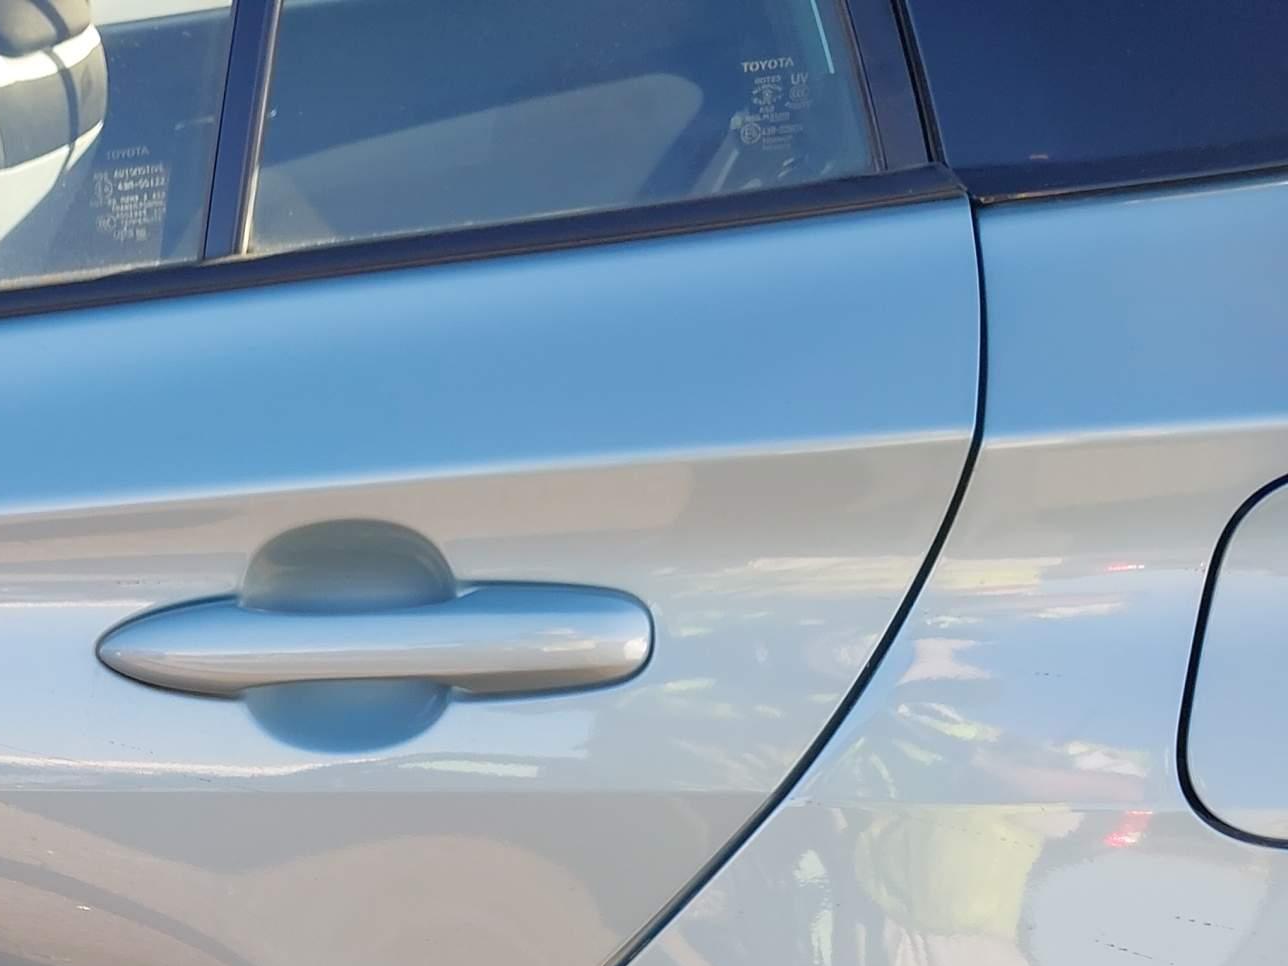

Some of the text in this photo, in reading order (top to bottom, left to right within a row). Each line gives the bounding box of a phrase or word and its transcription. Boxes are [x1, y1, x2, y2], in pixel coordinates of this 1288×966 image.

[741, 57, 794, 72] TOYOTA
[791, 72, 809, 85] UV
[106, 145, 150, 160] TOYOTA
